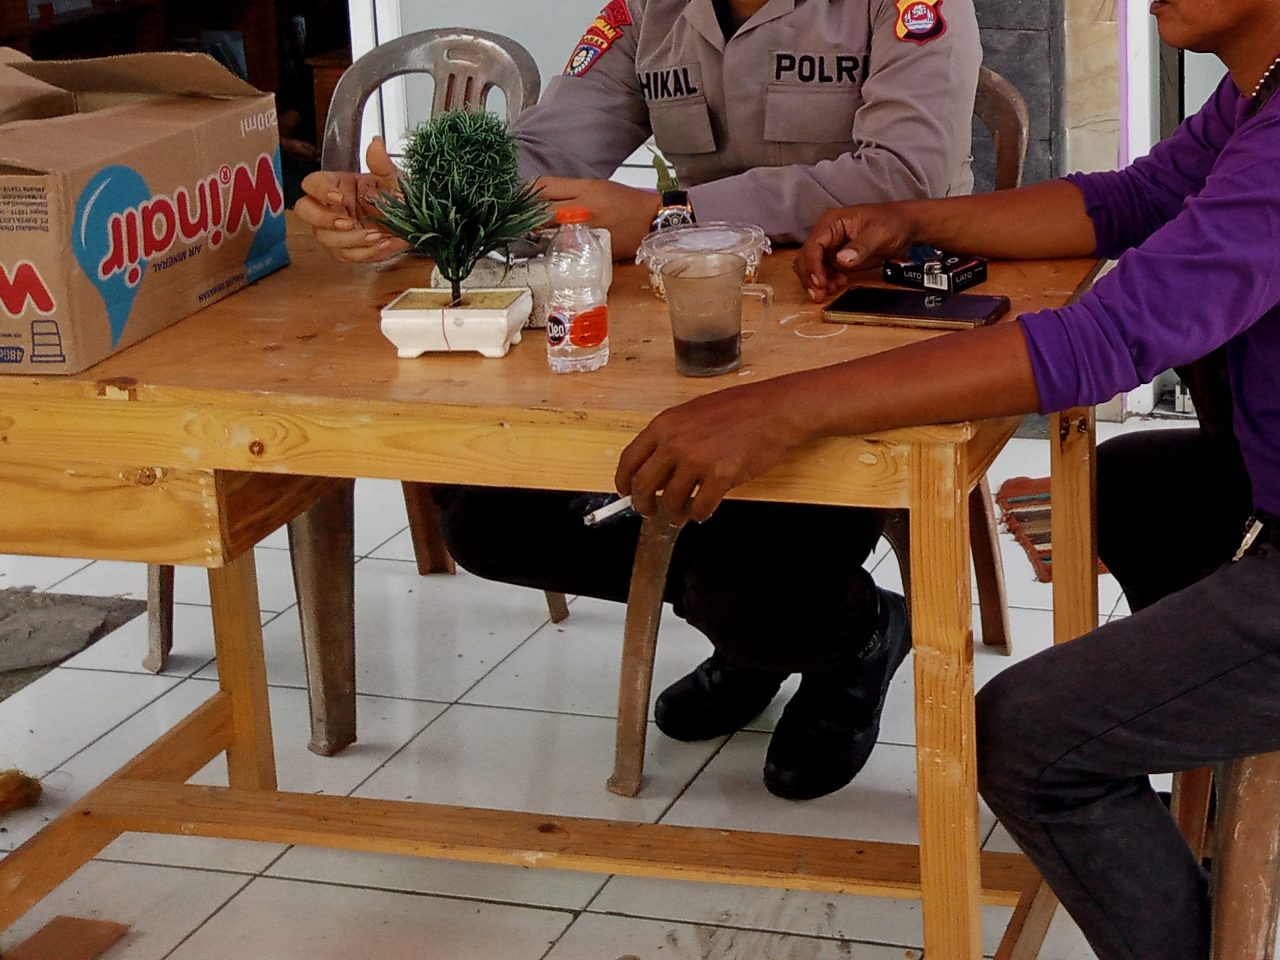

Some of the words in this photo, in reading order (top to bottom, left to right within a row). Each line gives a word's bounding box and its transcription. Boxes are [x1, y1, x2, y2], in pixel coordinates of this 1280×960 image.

[775, 53, 870, 82] POLRI
[99, 153, 285, 287] Winair
[152, 249, 187, 273] MINERAL
[187, 244, 202, 259] AIR
[547, 321, 565, 338] Cleo
